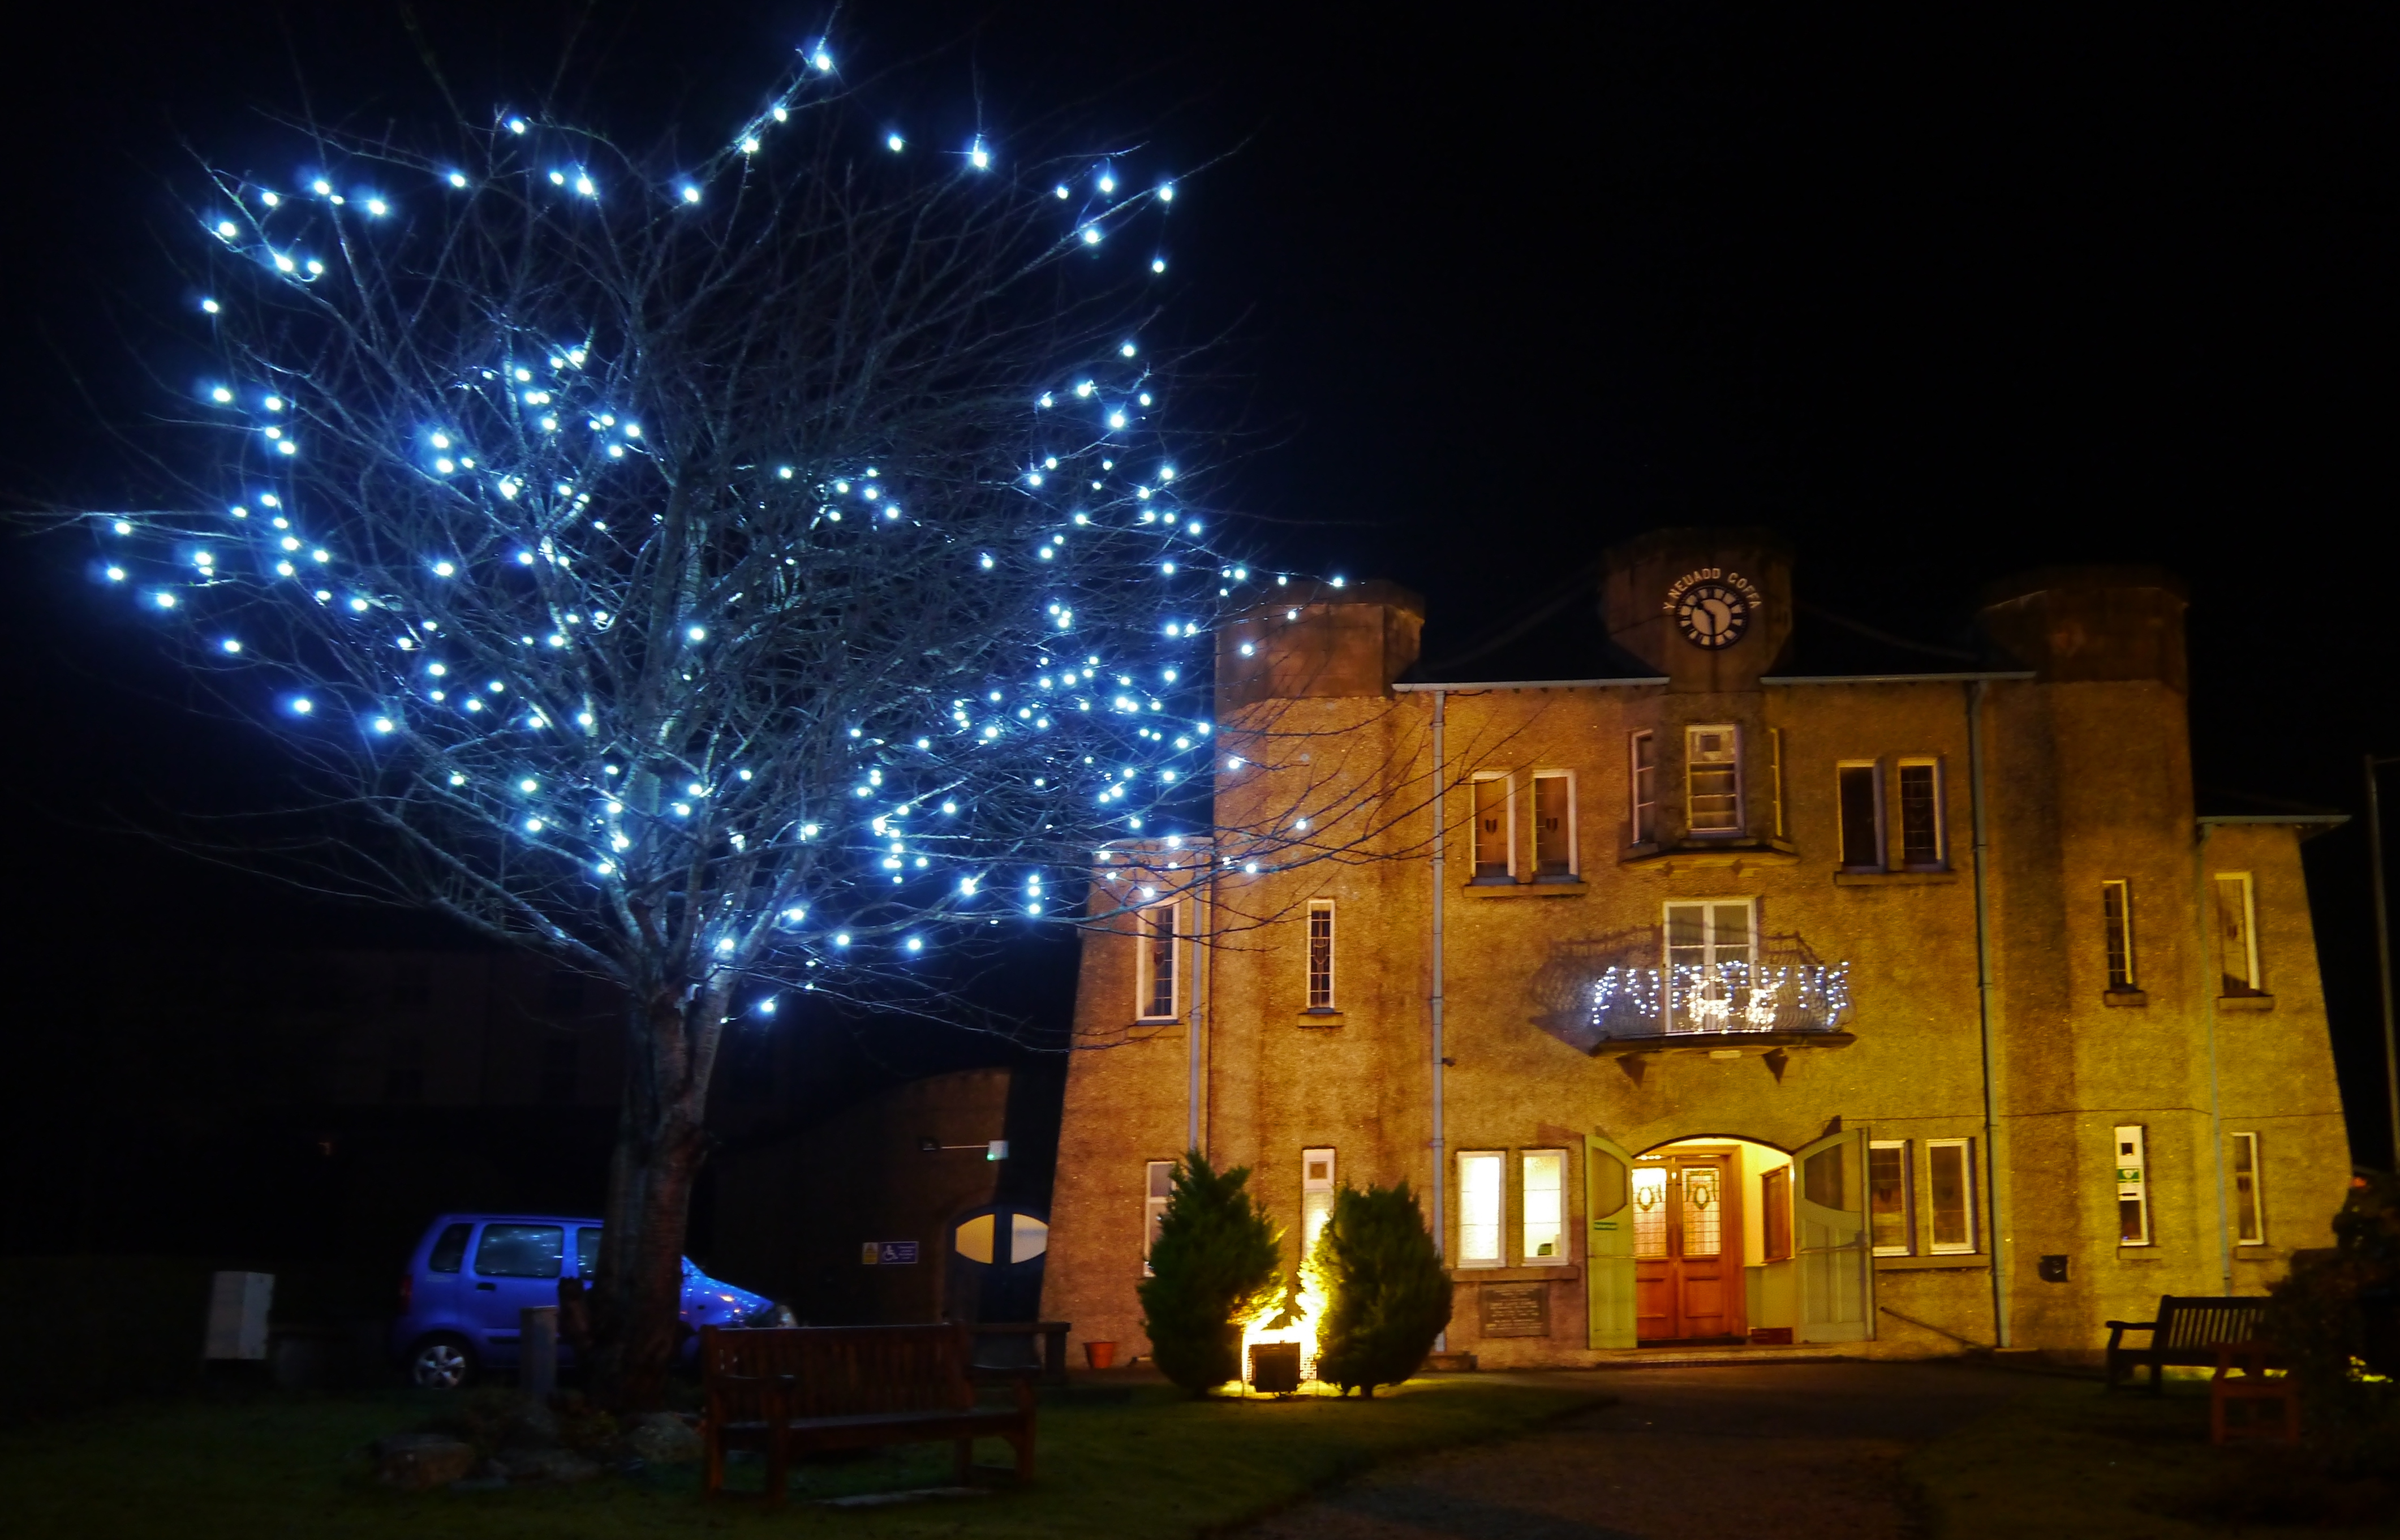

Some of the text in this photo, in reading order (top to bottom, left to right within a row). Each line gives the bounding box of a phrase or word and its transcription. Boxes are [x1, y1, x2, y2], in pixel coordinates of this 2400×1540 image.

[1662, 567, 1763, 610] Y NEUADD COFFA
